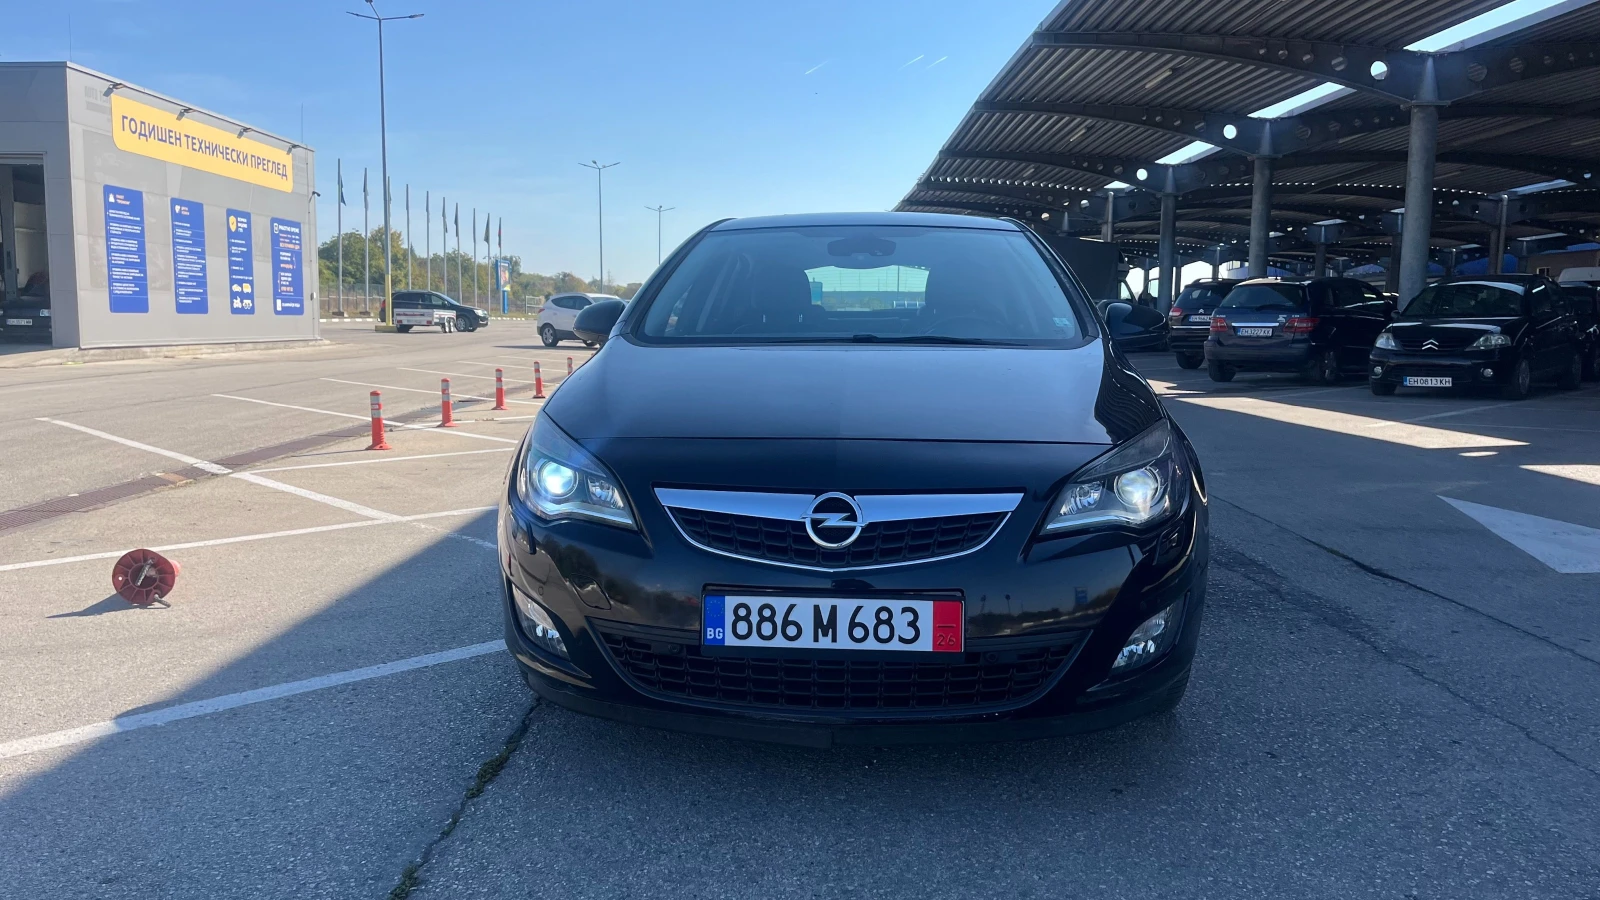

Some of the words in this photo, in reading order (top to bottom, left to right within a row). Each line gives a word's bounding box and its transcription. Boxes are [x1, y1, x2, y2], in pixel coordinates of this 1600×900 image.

[121, 115, 182, 148] ГОДИШЕН
[184, 134, 249, 167] ТЕХНИЧЕСКИ
[250, 154, 288, 180] ПРЕГЛЕД
[706, 627, 724, 640] BG
[731, 603, 803, 642] 886
[812, 604, 838, 643] M
[847, 605, 921, 644] 683
[936, 632, 956, 646] 26
